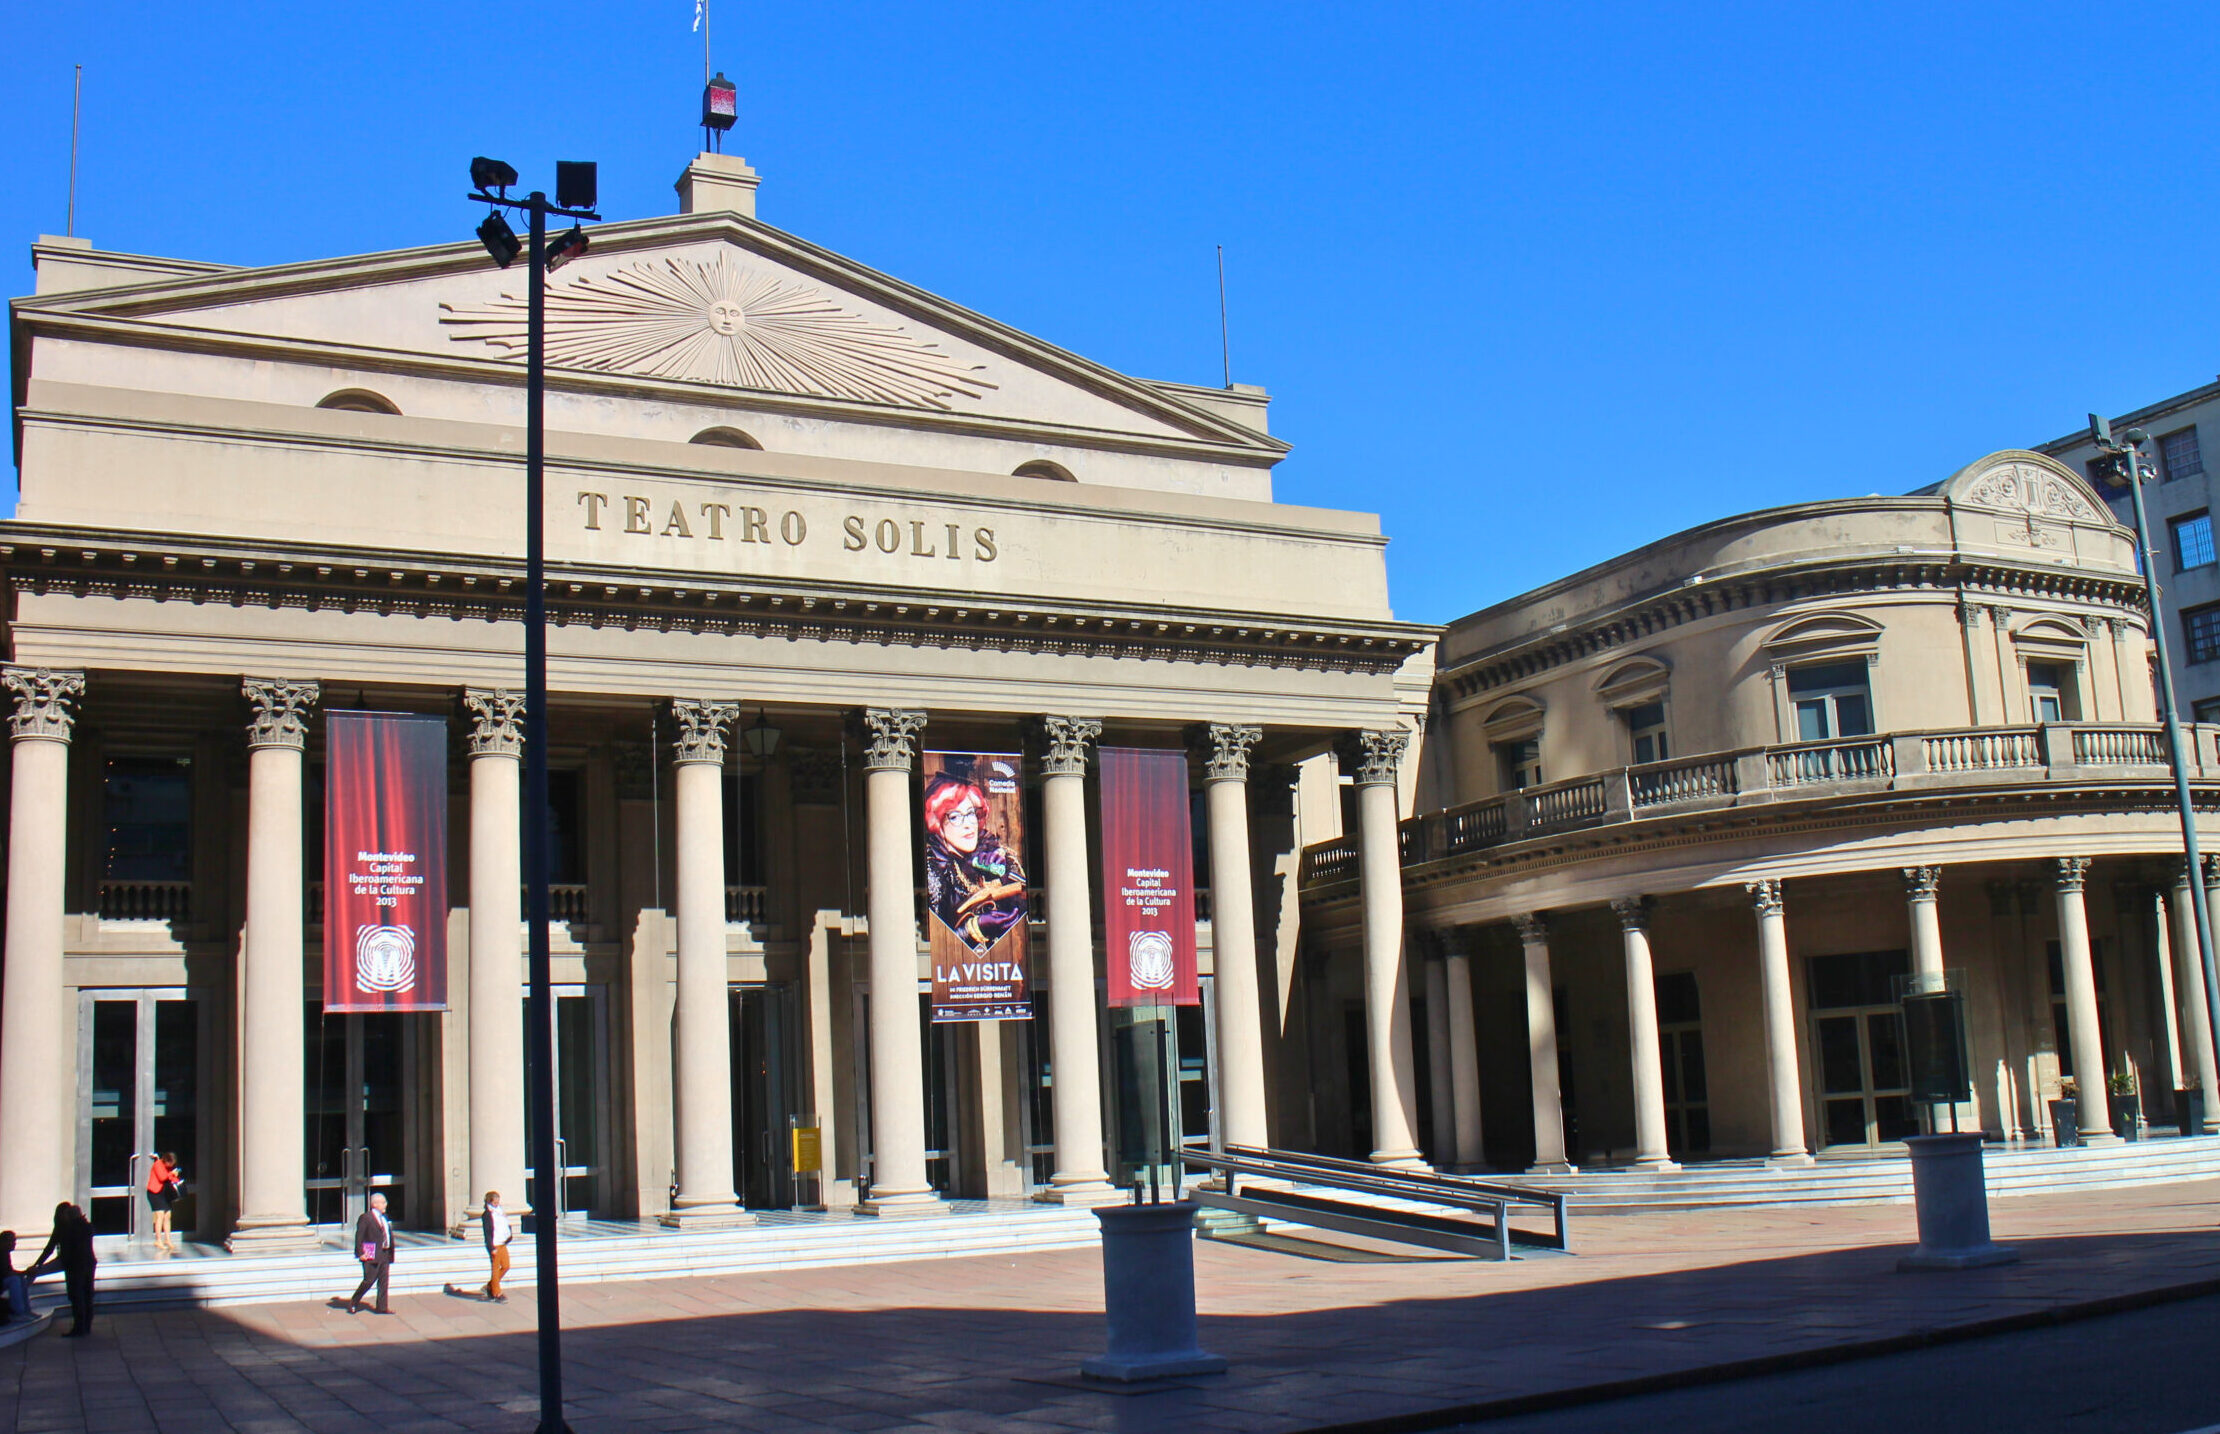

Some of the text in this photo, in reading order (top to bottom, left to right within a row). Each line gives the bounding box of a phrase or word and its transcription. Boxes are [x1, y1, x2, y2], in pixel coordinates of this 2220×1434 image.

[577, 490, 999, 563] TEATRO SOLIS
[357, 851, 416, 863] Montevideo
[369, 863, 404, 874] Capital
[1127, 868, 1170, 879] Montevideo
[349, 874, 424, 884] Iberoamericana
[1136, 878, 1162, 888] Capital
[354, 885, 416, 895] de la Cultura
[1121, 887, 1177, 897] Iberoamericana
[376, 897, 398, 907] 2013
[1126, 897, 1171, 906] de la Cultura
[1142, 907, 1158, 917] 2013
[936, 962, 1024, 983] LA VISITA
